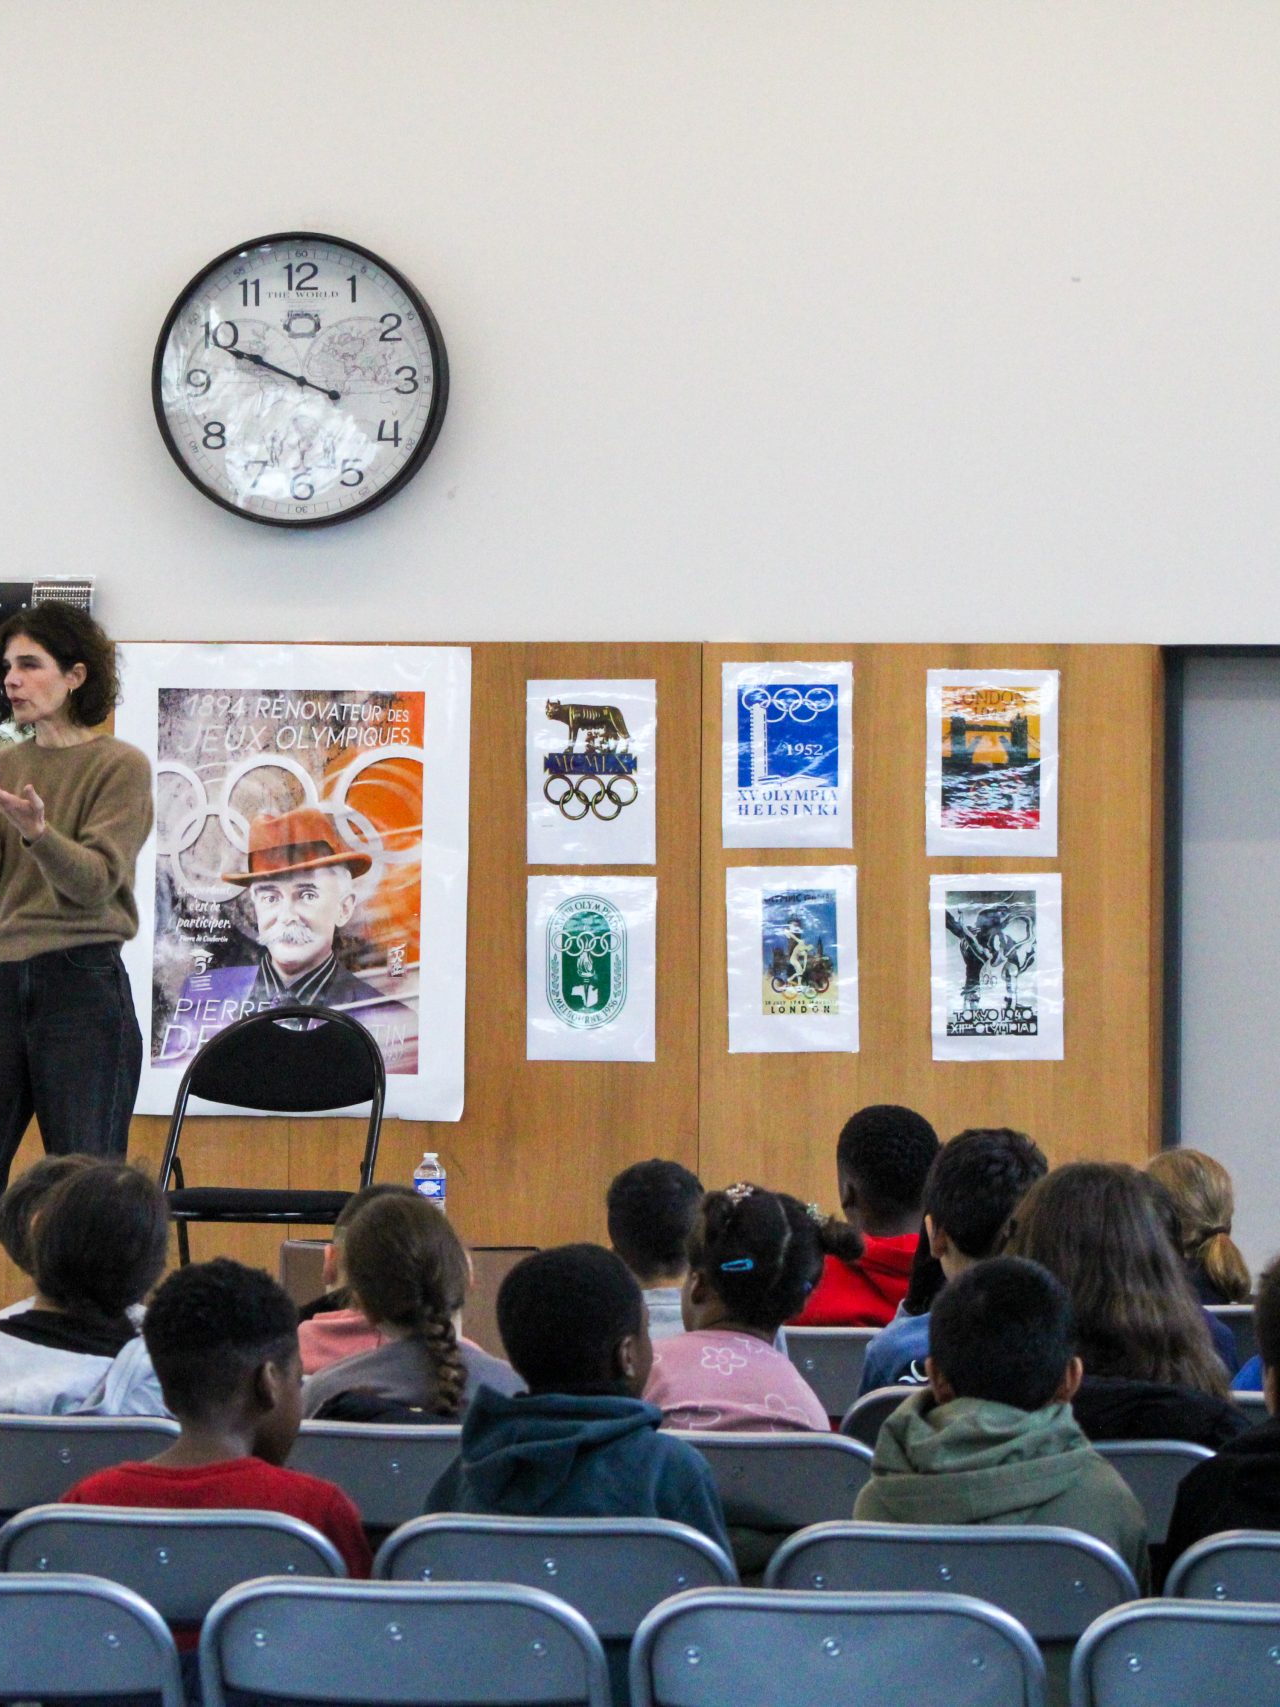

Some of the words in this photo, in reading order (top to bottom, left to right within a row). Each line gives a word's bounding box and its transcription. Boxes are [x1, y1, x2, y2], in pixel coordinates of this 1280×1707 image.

[283, 262, 319, 291] 12
[346, 274, 357, 304] 1
[238, 278, 260, 307] 11
[267, 291, 290, 299] THE
[295, 291, 339, 299] WORLD
[200, 320, 239, 349] 10
[379, 313, 402, 342] 2
[186, 368, 212, 398] 9
[393, 365, 419, 394] 3
[202, 421, 226, 450] 8
[376, 419, 402, 447] 4
[243, 460, 268, 489] 7
[290, 472, 315, 501] 6
[339, 458, 364, 487] 5
[185, 693, 246, 717] 1894
[255, 694, 381, 722] RÉNOVATEUR
[387, 708, 410, 723] DES
[177, 724, 267, 753] JEUX
[276, 725, 412, 750] OLYMPIQUES
[786, 743, 824, 756] 1952
[738, 804, 838, 816] HELSINKI
[209, 900, 221, 912] de
[175, 916, 232, 934] participer.
[771, 1005, 830, 1014] LONDON
[953, 1009, 998, 1022] TOKYO
[1000, 1009, 1033, 1021] 1940
[975, 1022, 1037, 1036] OLYMPIAD
